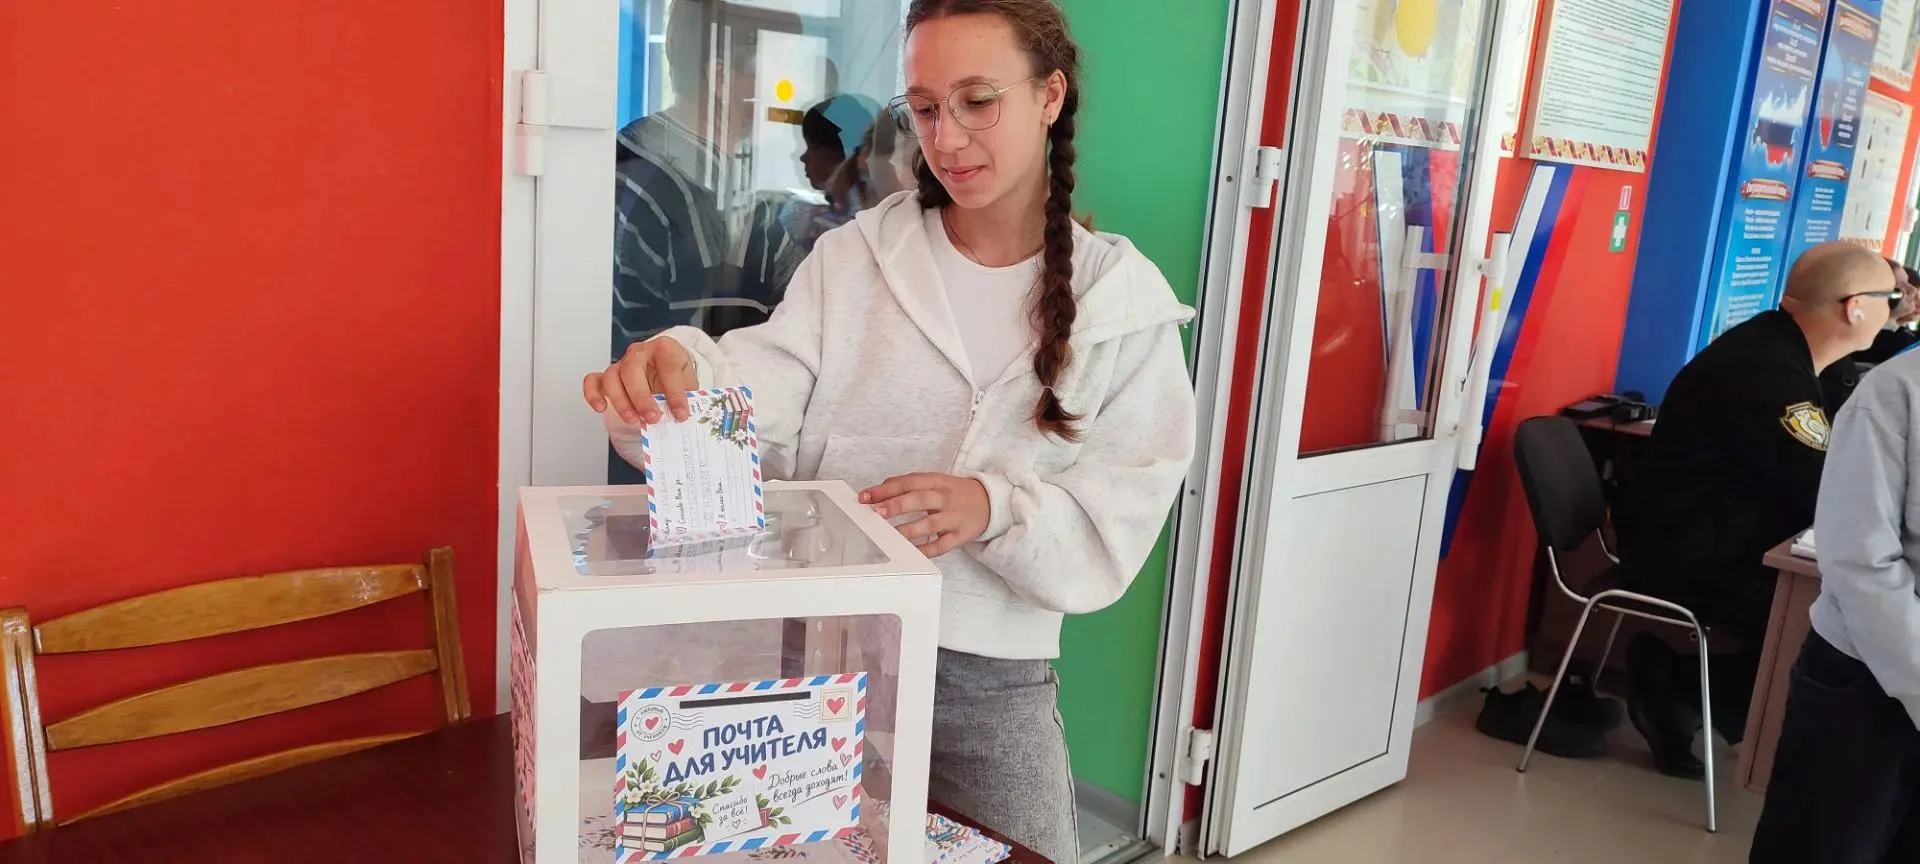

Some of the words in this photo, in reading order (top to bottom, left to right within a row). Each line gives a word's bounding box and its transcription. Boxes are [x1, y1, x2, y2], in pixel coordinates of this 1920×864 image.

[702, 714, 784, 750] ПОЧТА
[662, 752, 716, 788] ДЛЯ
[721, 727, 828, 771] УЧИТЕЛЯ
[767, 769, 807, 791] Добрые
[810, 759, 839, 777] слова
[772, 786, 804, 803] всегда
[805, 769, 849, 796] доходят!
[712, 794, 748, 815] Спасибо
[718, 814, 729, 827] за
